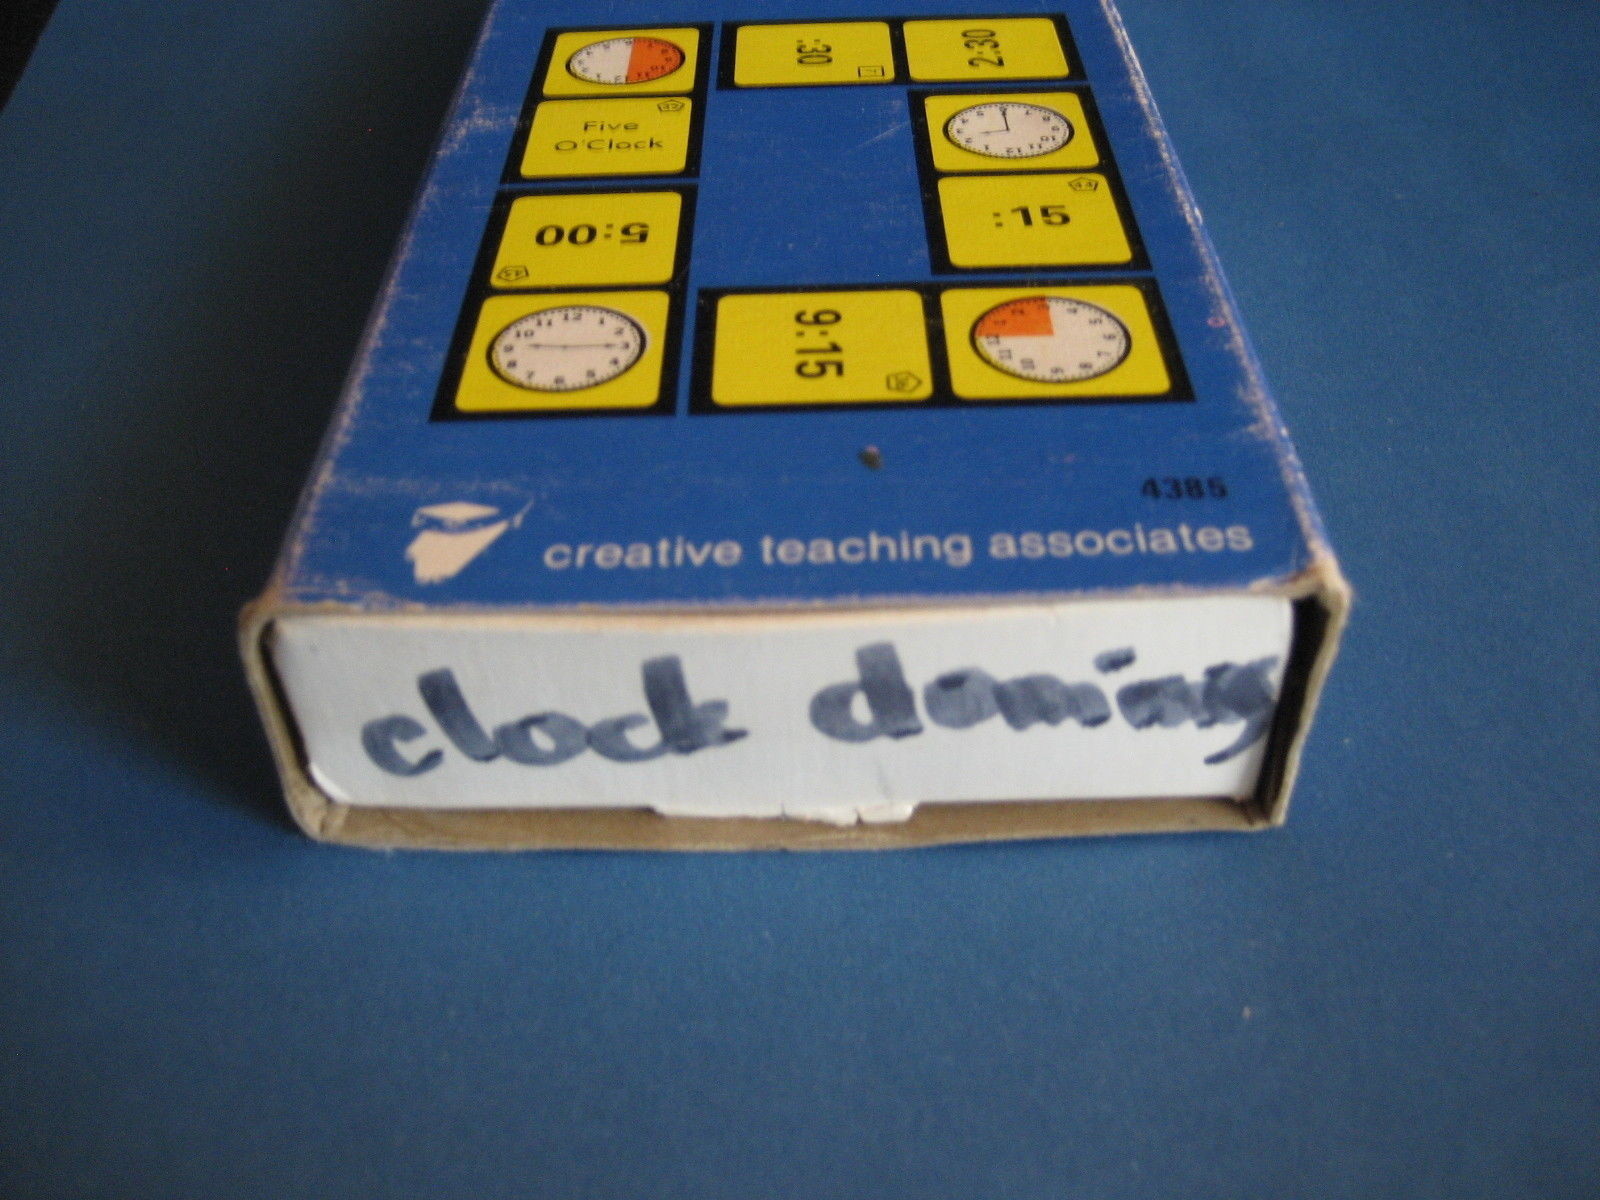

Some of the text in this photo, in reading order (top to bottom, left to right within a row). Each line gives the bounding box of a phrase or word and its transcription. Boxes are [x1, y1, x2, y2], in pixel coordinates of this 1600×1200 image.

[961, 29, 1005, 67] 2:30
[583, 120, 639, 132] Five
[555, 137, 664, 152] O'Clock
[993, 205, 1071, 226] :15
[535, 222, 650, 246] 5:00
[795, 309, 844, 378] 9:15
[1142, 477, 1228, 499] 4385
[543, 521, 1254, 570] creative teaching associates
